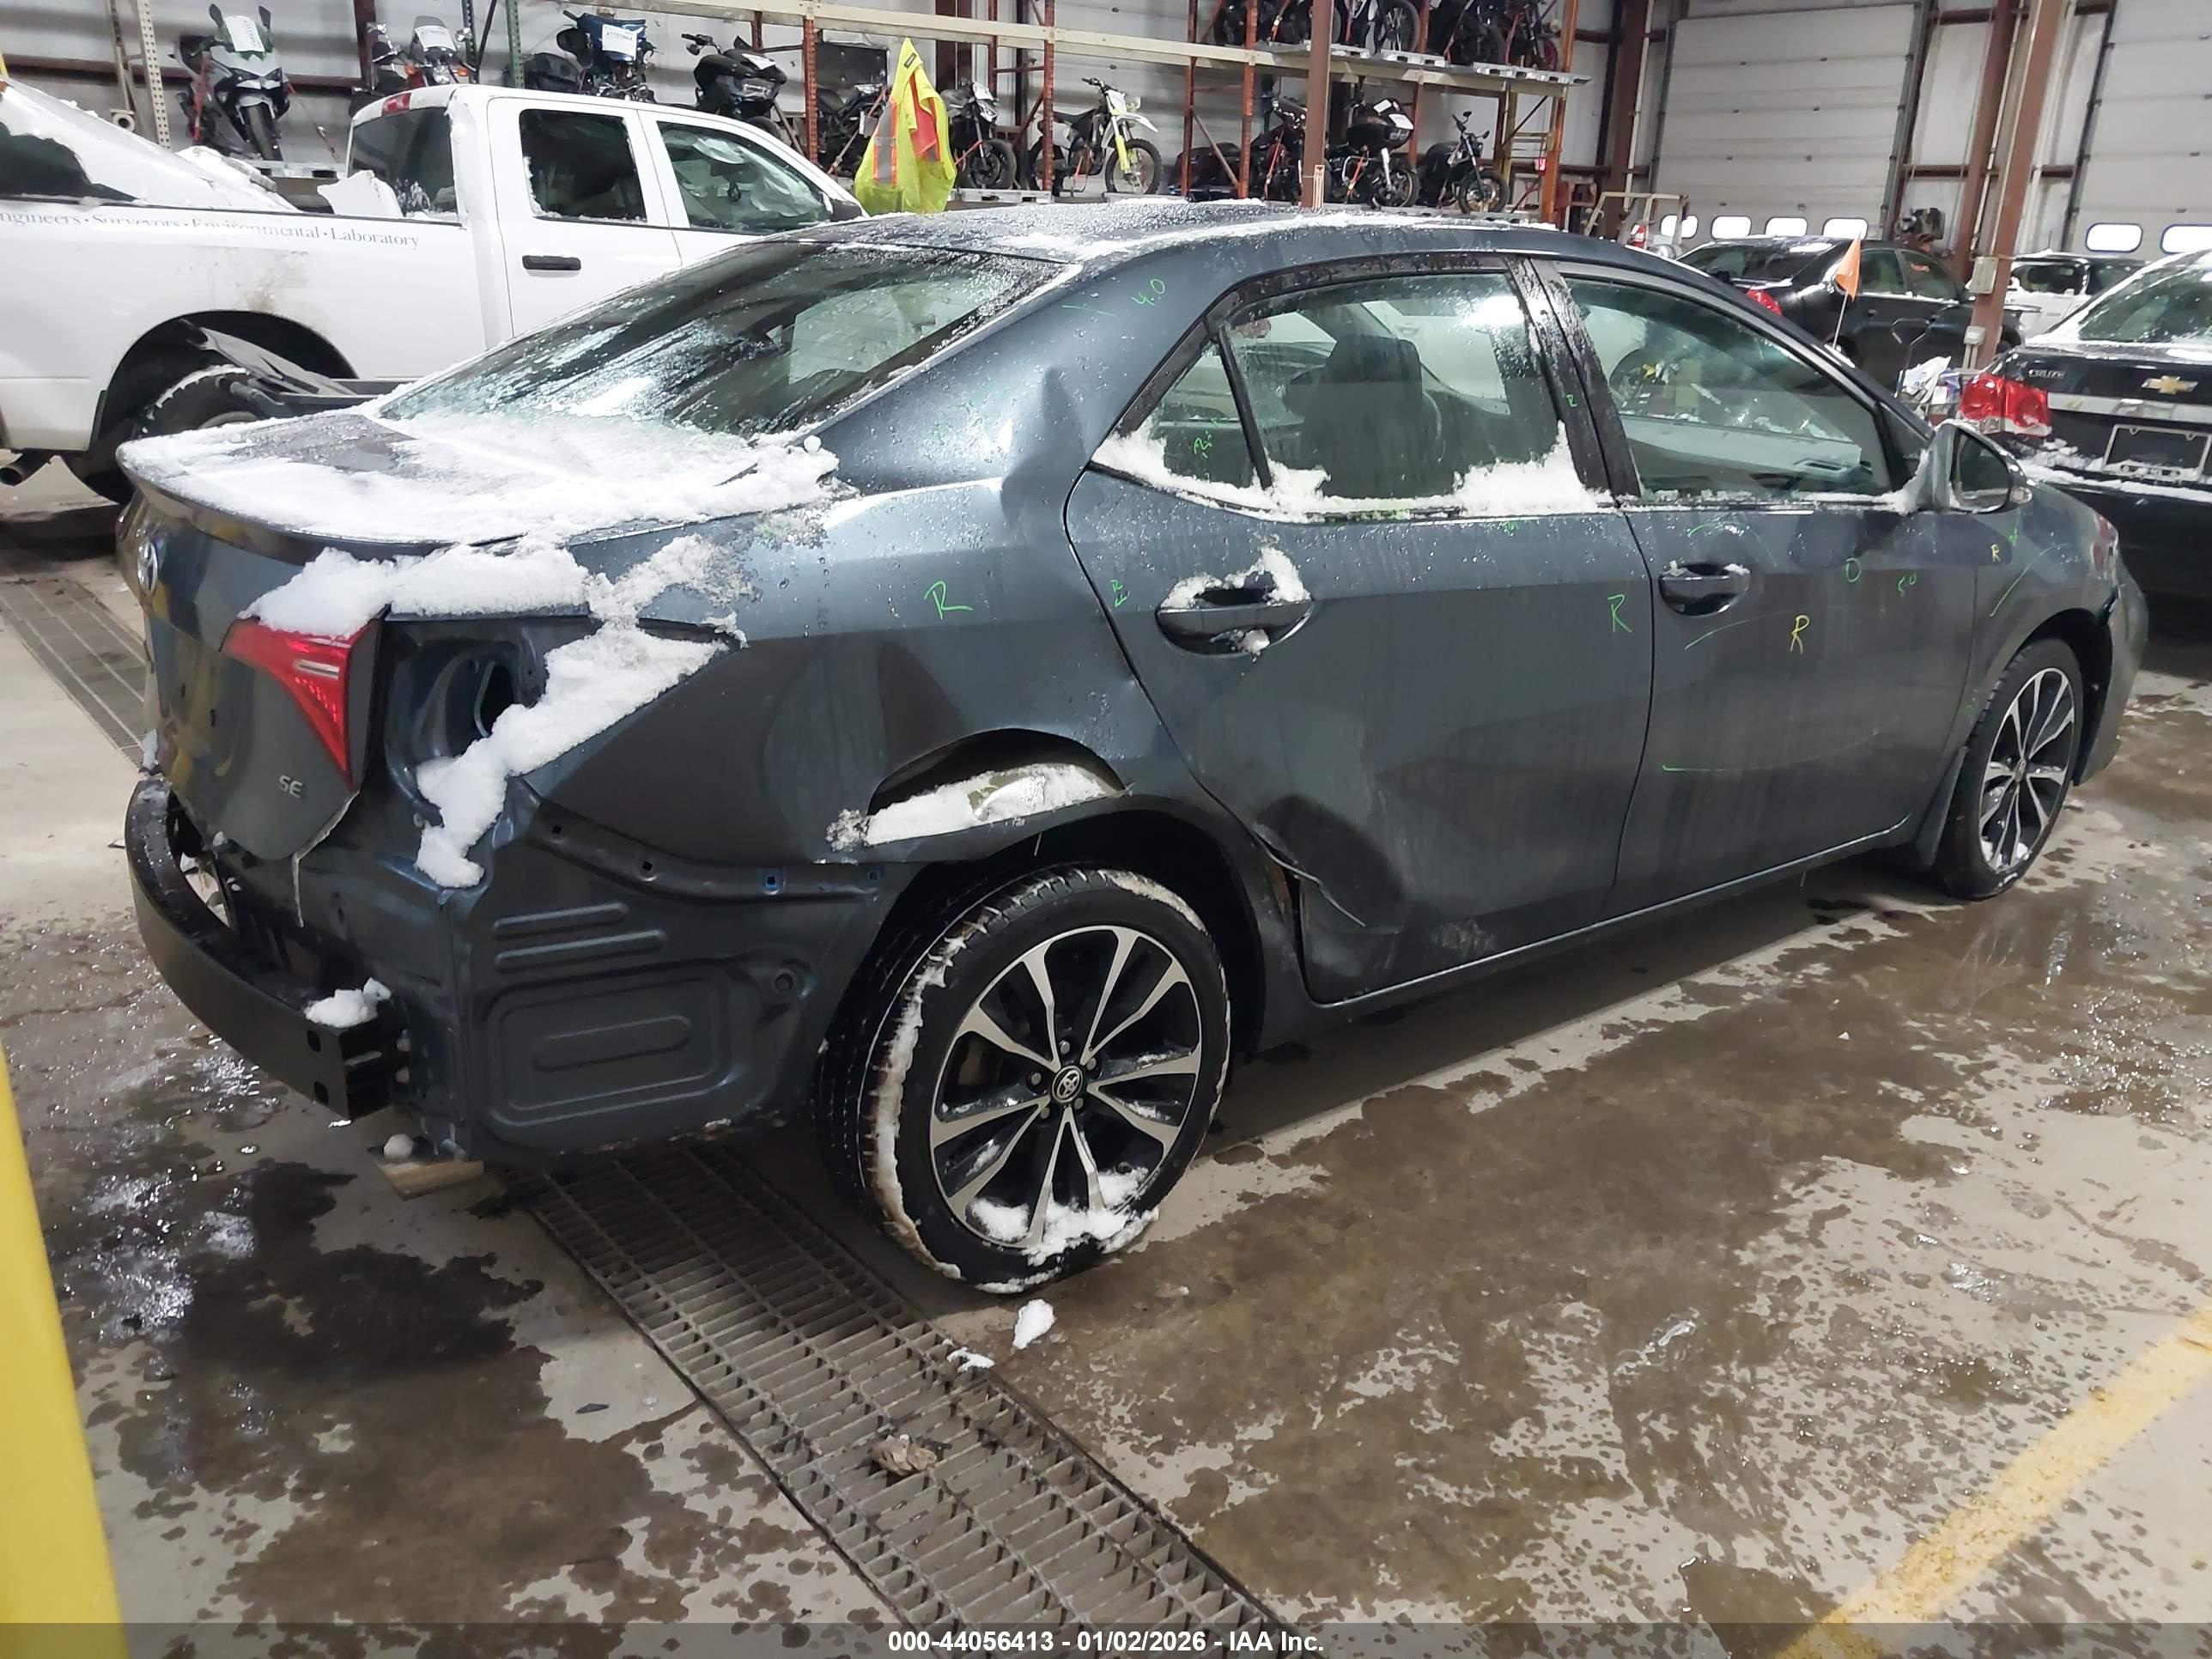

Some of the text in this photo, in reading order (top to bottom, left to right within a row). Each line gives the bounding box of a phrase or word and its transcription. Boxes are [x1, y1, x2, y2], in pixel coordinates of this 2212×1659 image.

[0, 212, 81, 227] ngineers
[331, 228, 419, 251] Laboratory
[924, 580, 974, 620] R
[1607, 593, 1632, 633] R
[1790, 614, 1810, 654] R
[278, 775, 303, 799] SE
